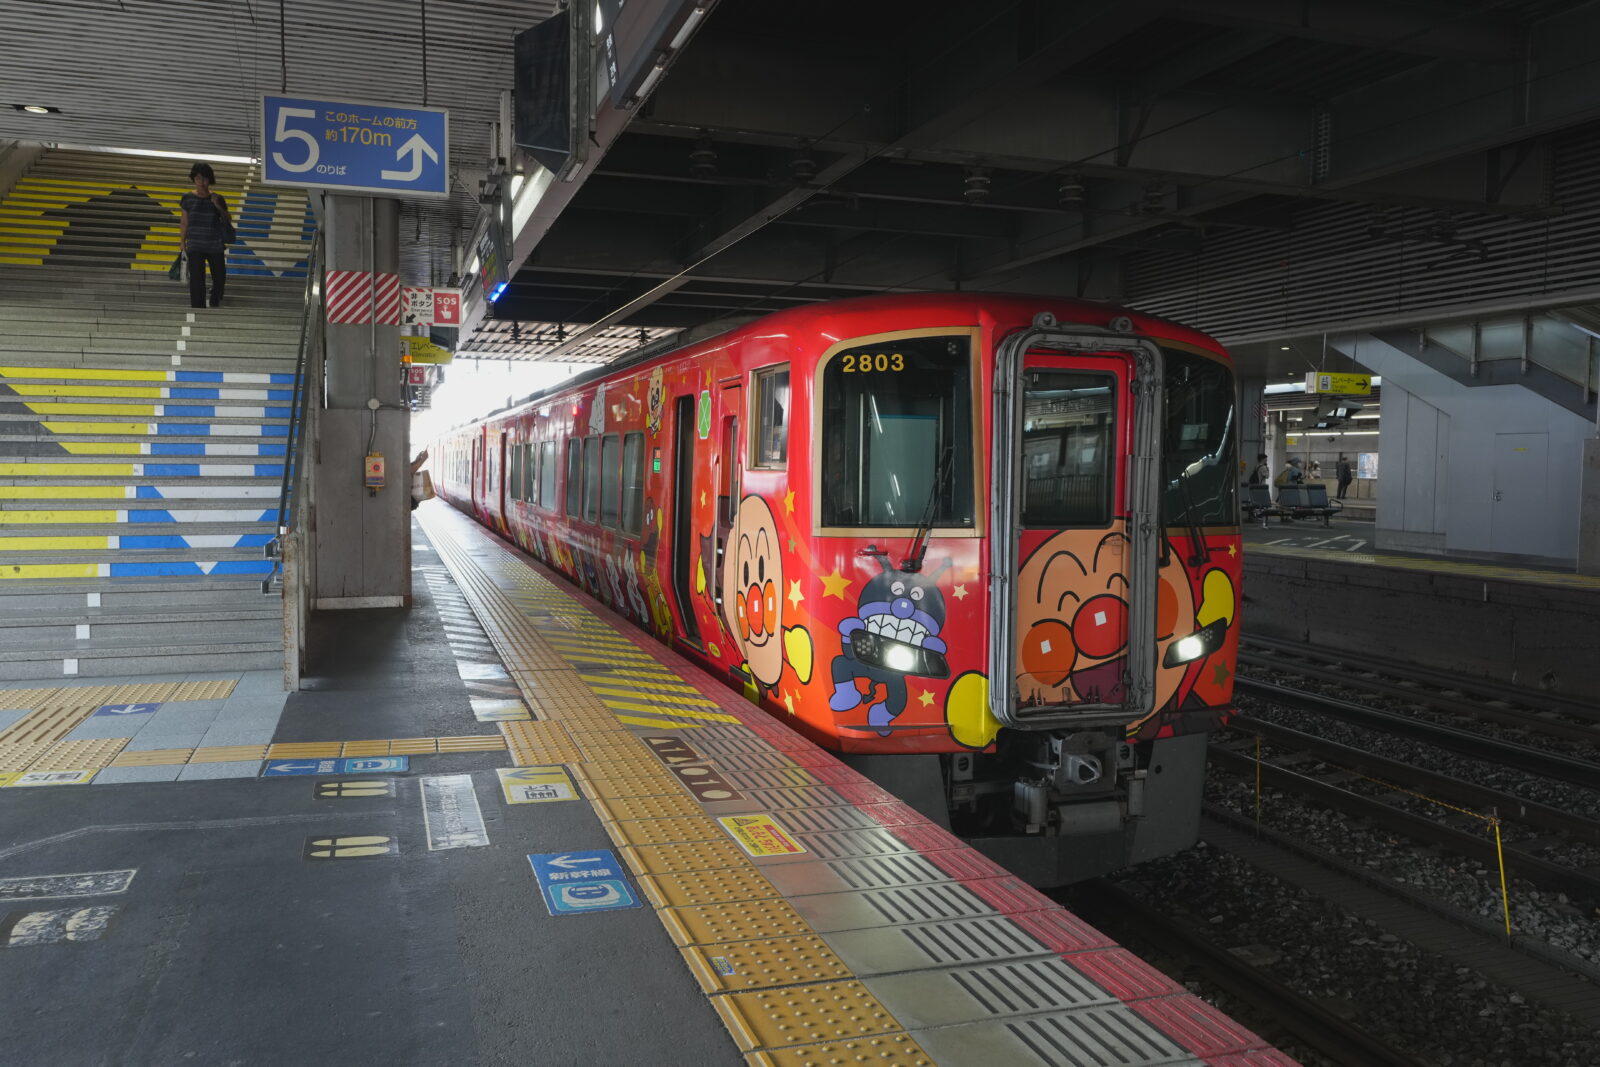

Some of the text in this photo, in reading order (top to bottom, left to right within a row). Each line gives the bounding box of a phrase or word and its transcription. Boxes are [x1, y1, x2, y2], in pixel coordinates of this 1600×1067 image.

[325, 111, 418, 130] このホームの前方
[272, 106, 320, 173] 5
[325, 126, 392, 147] 約170m
[316, 164, 347, 175] のりば
[411, 300, 433, 308] ボタン
[436, 297, 457, 305] SOS
[842, 353, 905, 373] 2803
